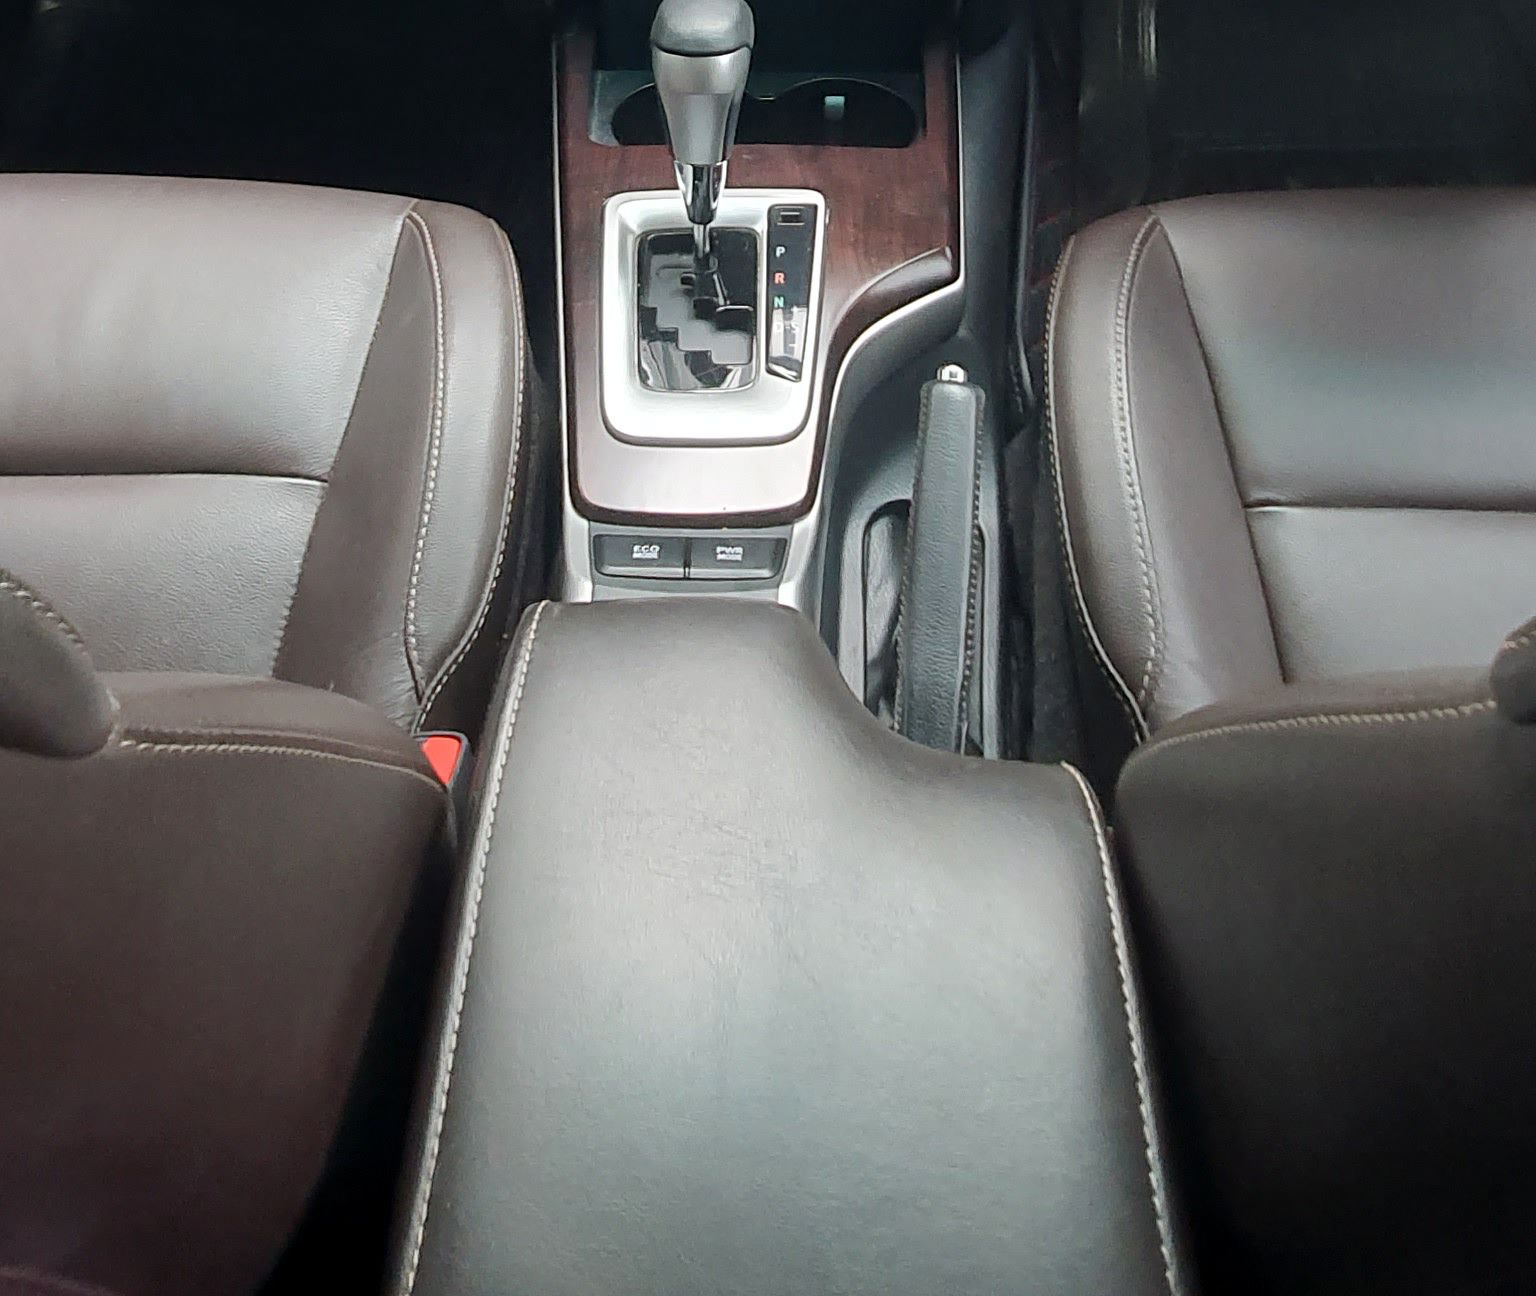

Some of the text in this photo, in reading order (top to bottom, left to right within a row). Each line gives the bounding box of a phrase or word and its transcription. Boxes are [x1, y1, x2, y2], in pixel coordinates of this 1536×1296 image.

[775, 246, 786, 258] P
[773, 271, 785, 284] R
[773, 296, 785, 309] N
